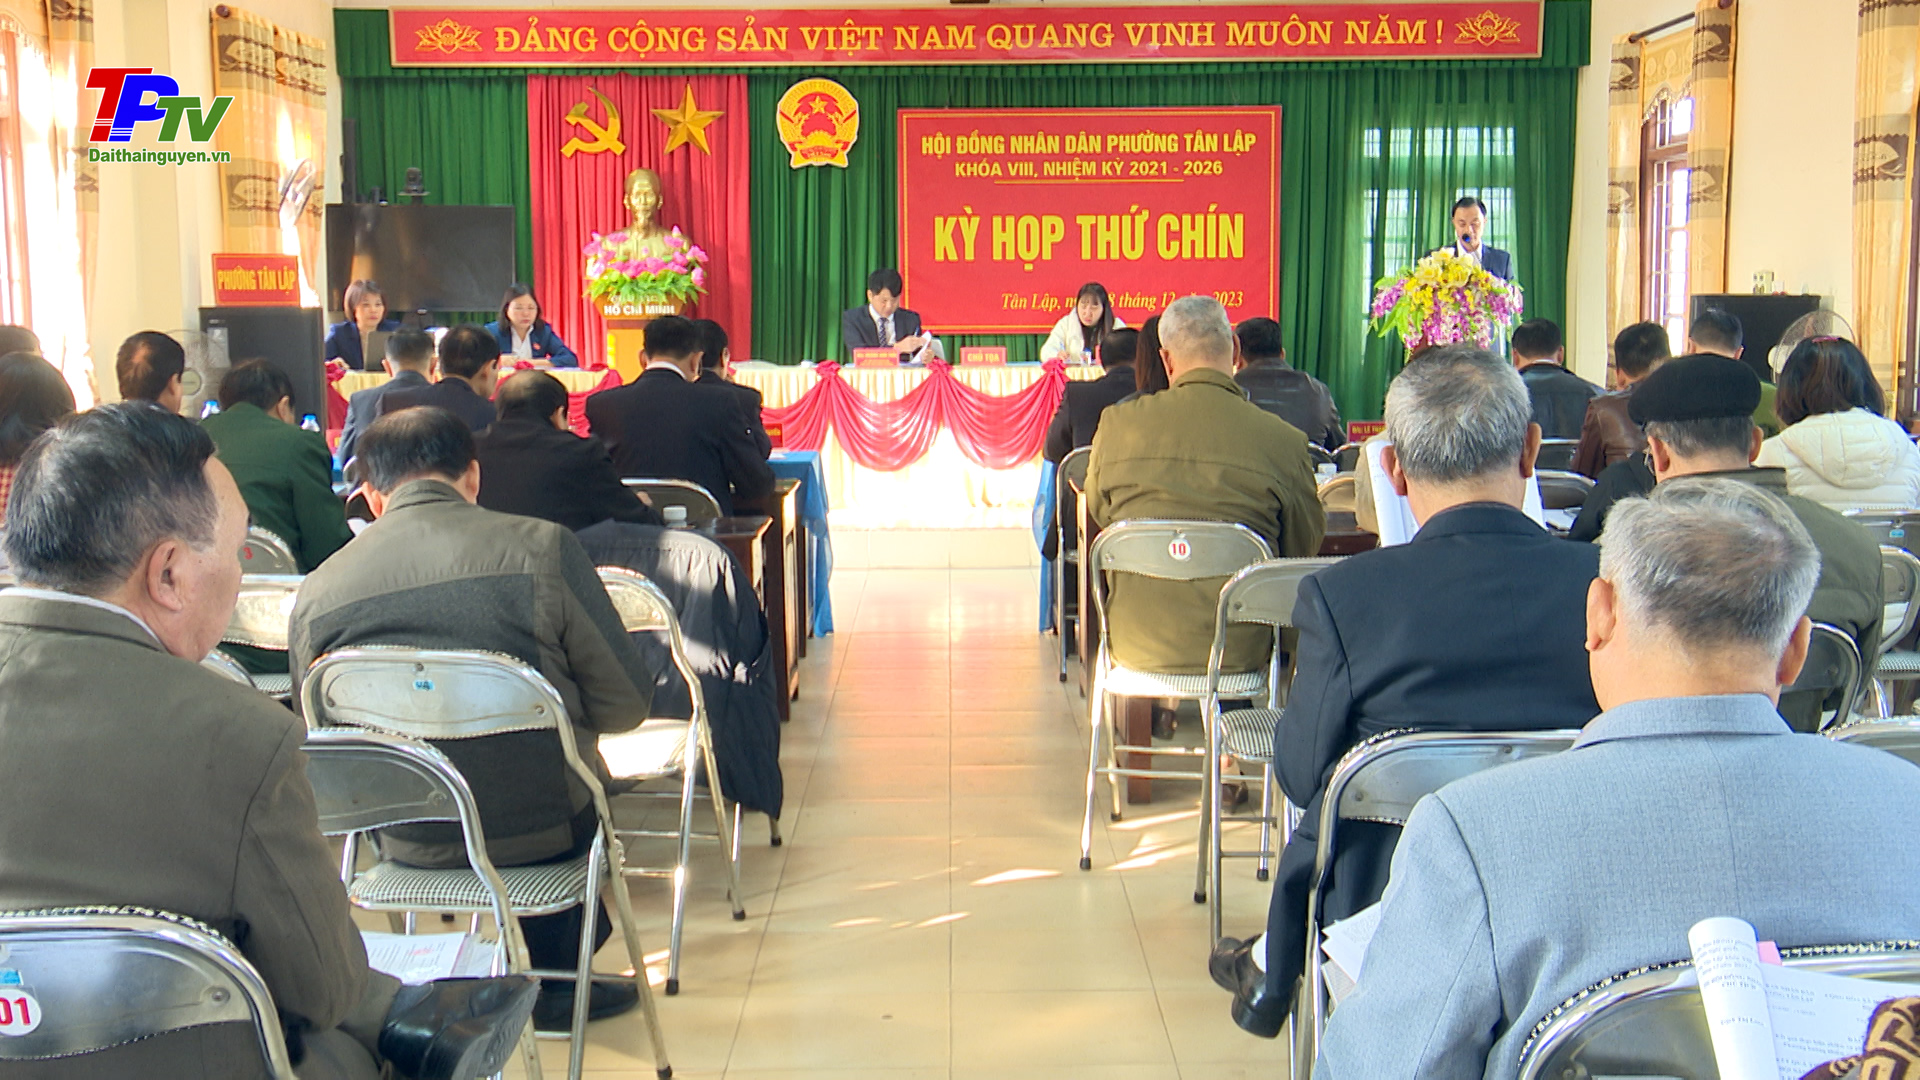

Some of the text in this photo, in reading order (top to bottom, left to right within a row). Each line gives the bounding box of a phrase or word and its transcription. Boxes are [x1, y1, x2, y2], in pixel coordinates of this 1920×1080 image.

[494, 15, 598, 52] ĐẢNG
[607, 19, 707, 58] CỘNG
[716, 15, 789, 51] SẢN
[799, 18, 884, 56] VIỆT
[893, 25, 977, 51] NAM
[986, 23, 1114, 51] QUANG
[1123, 22, 1216, 47] VINH
[1226, 14, 1334, 47] MUÔN
[1344, 14, 1427, 45] NĂM
[921, 129, 1257, 159] HỘI ĐỒNG NHÂN DÂN PHƯỜNG TÂN LẬP
[954, 158, 1003, 178] KHÓA
[1007, 161, 1039, 178] VIII,
[1043, 156, 1097, 181] NHIỆM
[1129, 160, 1168, 176] 2021
[1183, 160, 1223, 176] 2026
[934, 203, 1244, 271] KỲ HỌP THỨ CHÍN
[645, 304, 676, 315] MINH
[1002, 292, 1028, 310] Tân
[1031, 293, 1061, 313] Lập,
[1118, 292, 1157, 312] tháng
[1171, 542, 1187, 556] 10
